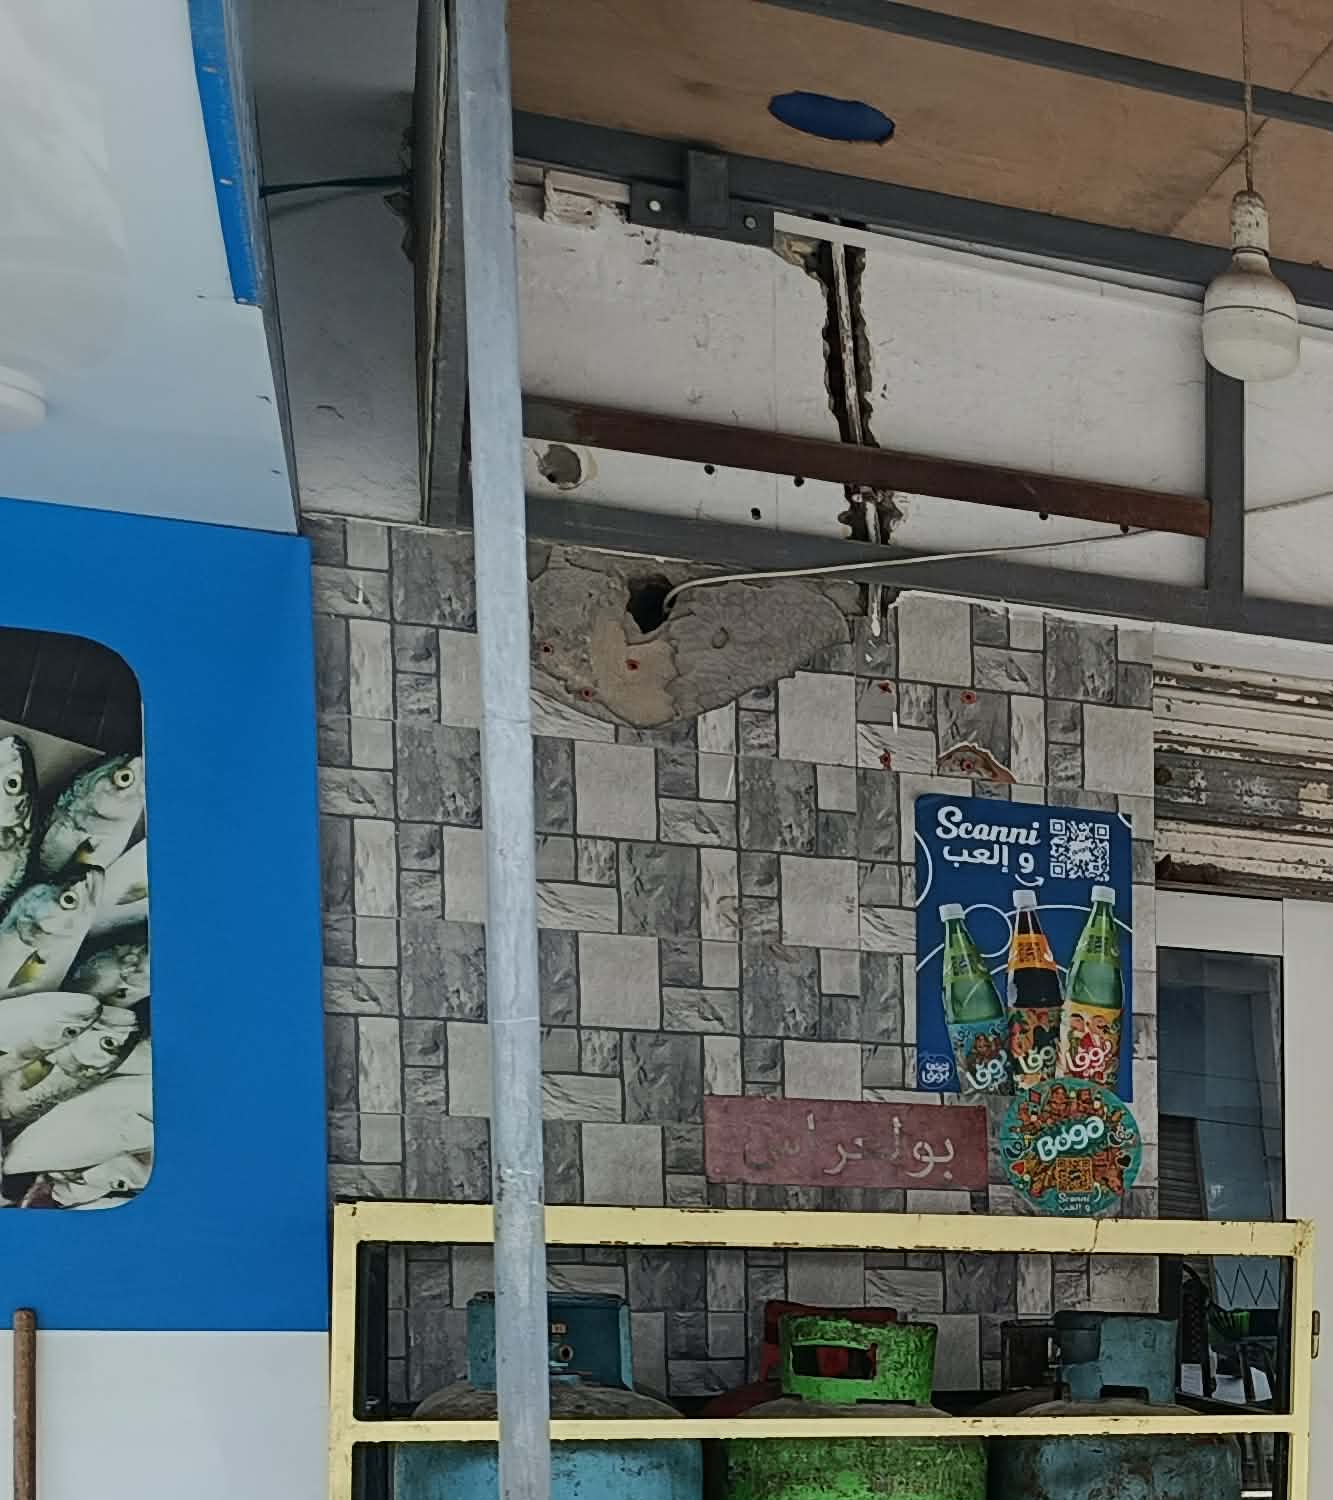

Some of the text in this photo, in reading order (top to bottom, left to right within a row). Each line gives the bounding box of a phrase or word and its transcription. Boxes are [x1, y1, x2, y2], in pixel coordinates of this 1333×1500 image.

[935, 805, 1042, 846] Scanni
[942, 843, 1035, 874] و إلعب
